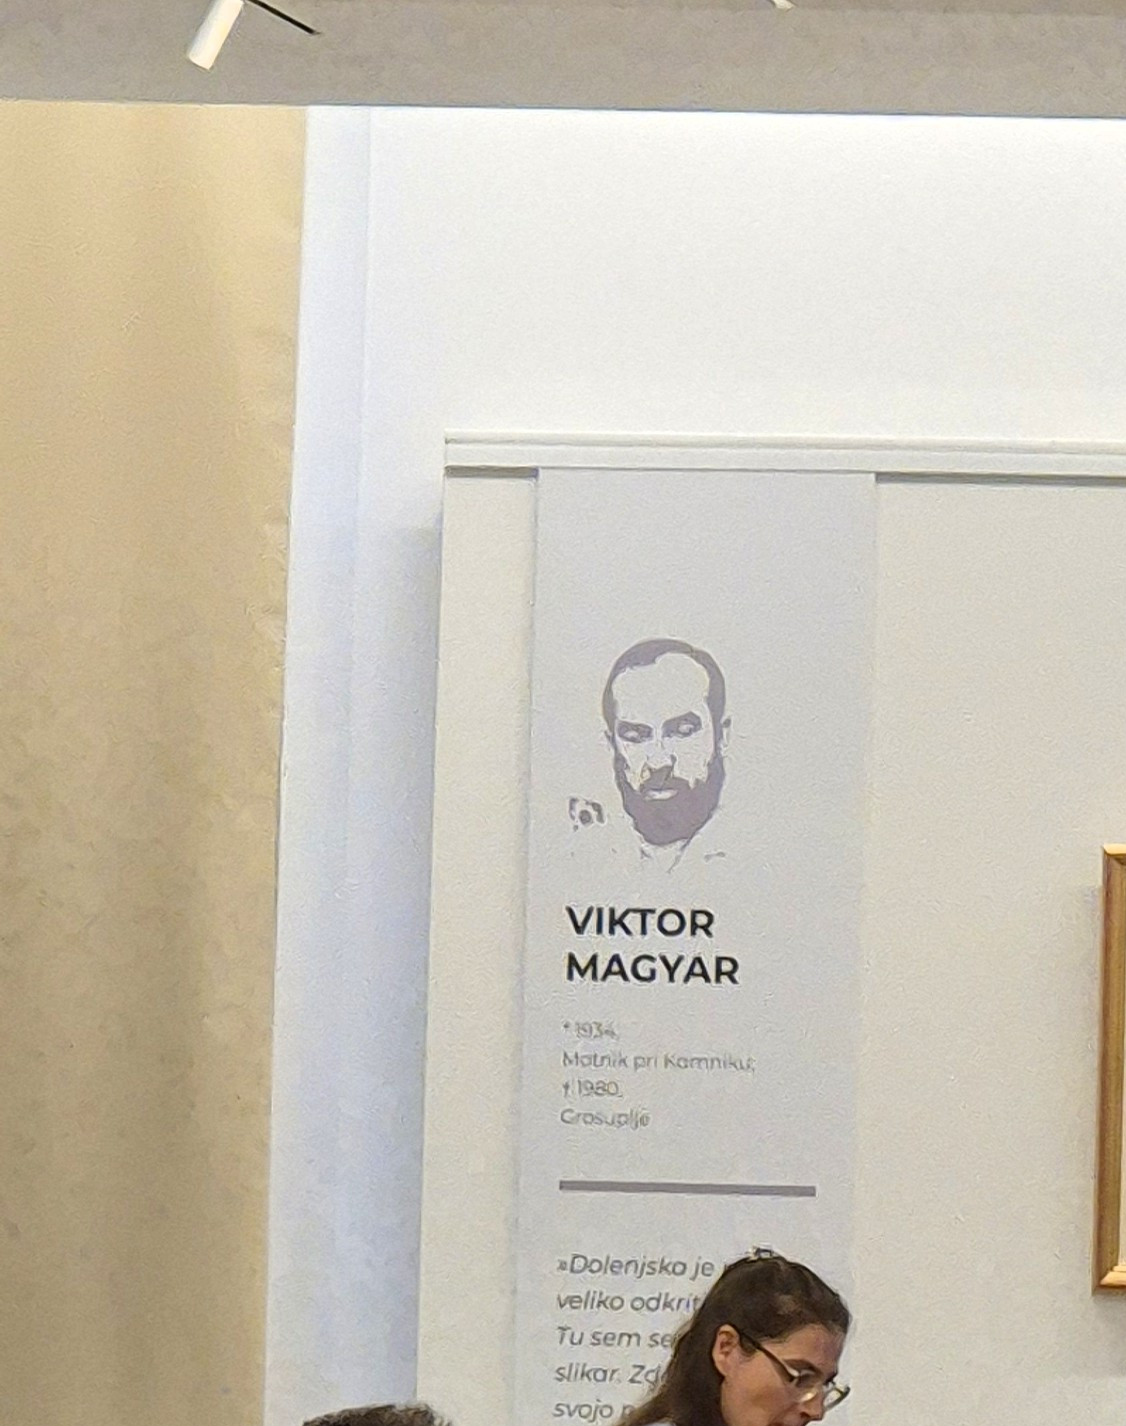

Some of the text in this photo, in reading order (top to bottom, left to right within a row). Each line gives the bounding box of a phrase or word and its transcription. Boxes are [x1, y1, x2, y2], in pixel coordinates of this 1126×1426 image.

[565, 906, 714, 938] VIKTOR
[565, 951, 739, 985] MAGYAR
[690, 1255, 715, 1281] je
[557, 1290, 625, 1312] veliko
[557, 1325, 585, 1346] Tu
[589, 1331, 642, 1348] sem
[551, 1398, 615, 1424] svojo
